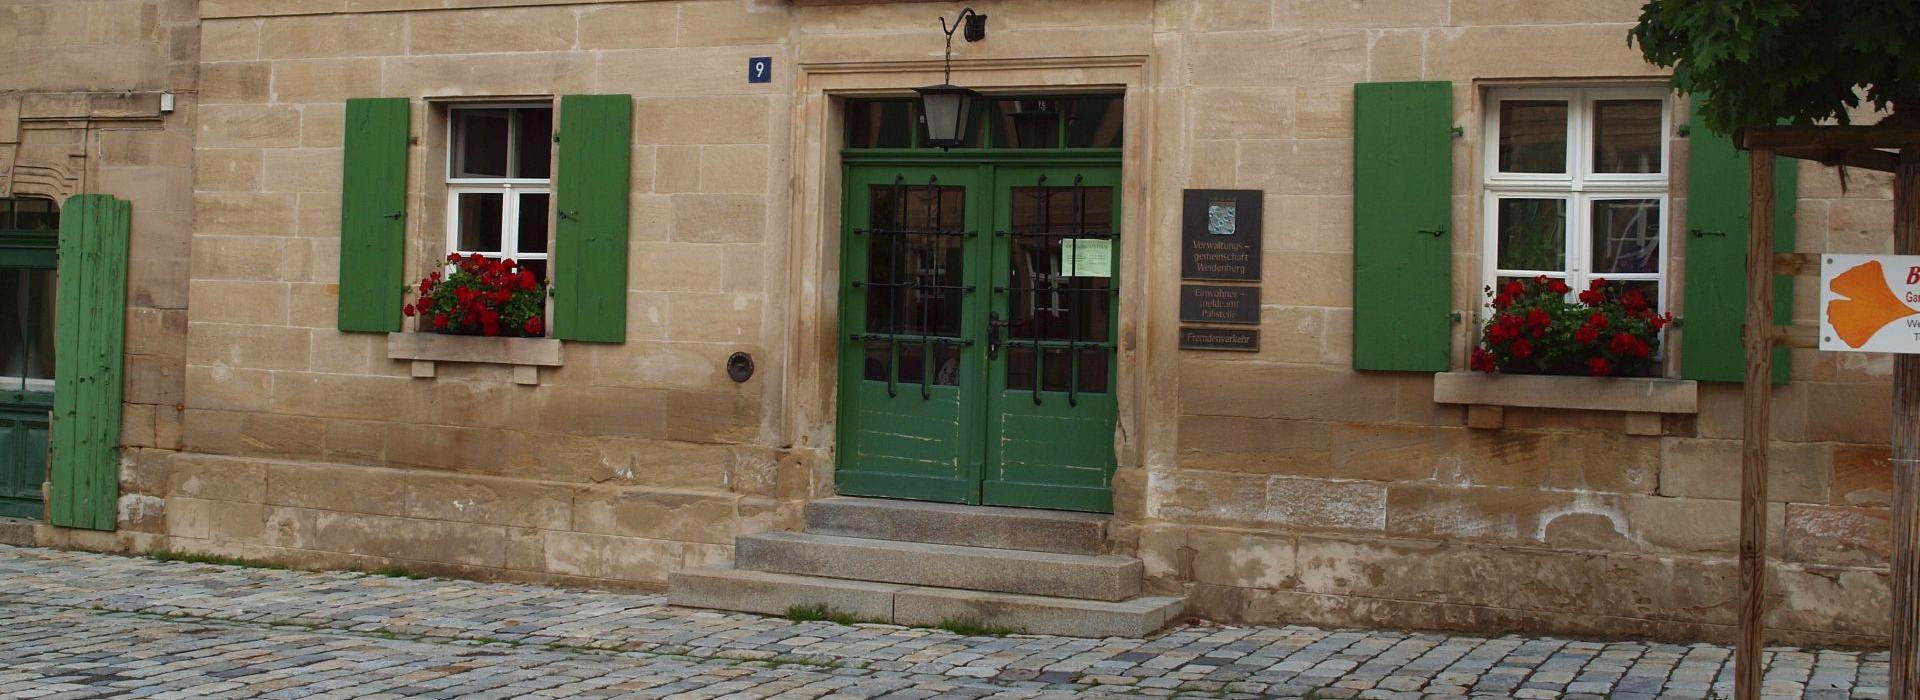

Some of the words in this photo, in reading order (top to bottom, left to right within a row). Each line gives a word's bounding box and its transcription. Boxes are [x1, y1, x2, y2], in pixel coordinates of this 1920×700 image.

[755, 61, 765, 78] 9
[1192, 252, 1249, 263] gemeinschaft
[1197, 263, 1246, 275] Weidenberg
[1187, 332, 1250, 344] Fremdenverkehr
